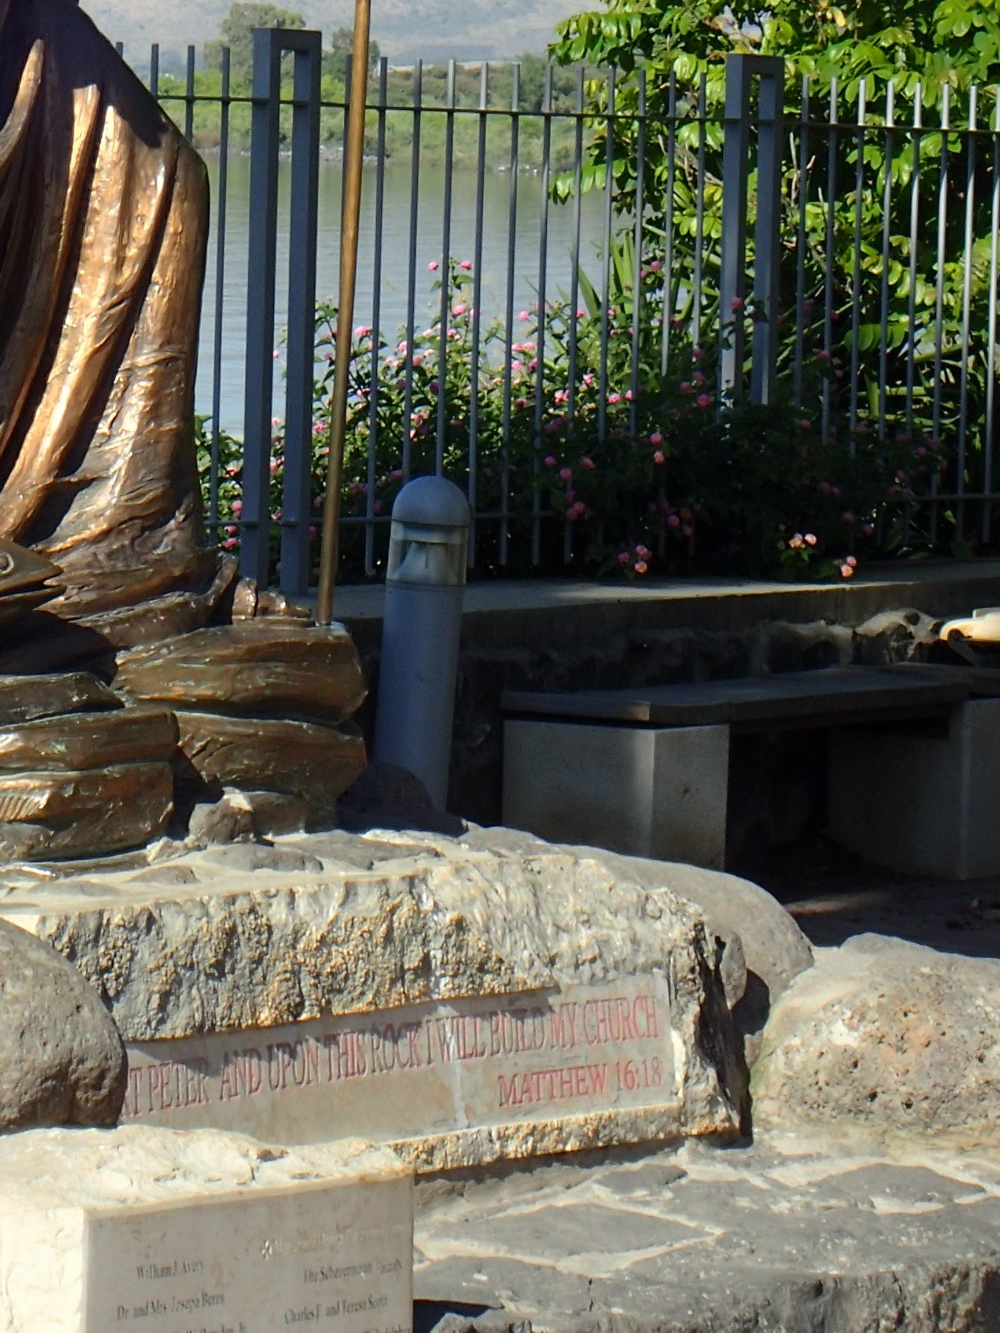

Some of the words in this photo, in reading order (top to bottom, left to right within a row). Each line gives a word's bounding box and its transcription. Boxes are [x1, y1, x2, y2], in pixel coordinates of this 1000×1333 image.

[120, 1066, 143, 1119] T
[146, 1057, 212, 1114] PETER
[218, 1048, 266, 1103] AND
[265, 1035, 321, 1093] UPON
[321, 1028, 367, 1084] THIS
[366, 1020, 421, 1076] ROCK
[424, 1019, 434, 1067] I
[434, 1013, 486, 1065] WILL
[488, 1008, 547, 1057] BUILD
[548, 1001, 578, 1050] MY
[582, 994, 659, 1046] CHURCH
[498, 1063, 608, 1108] MATTHEW
[614, 1055, 662, 1093] 16:18
